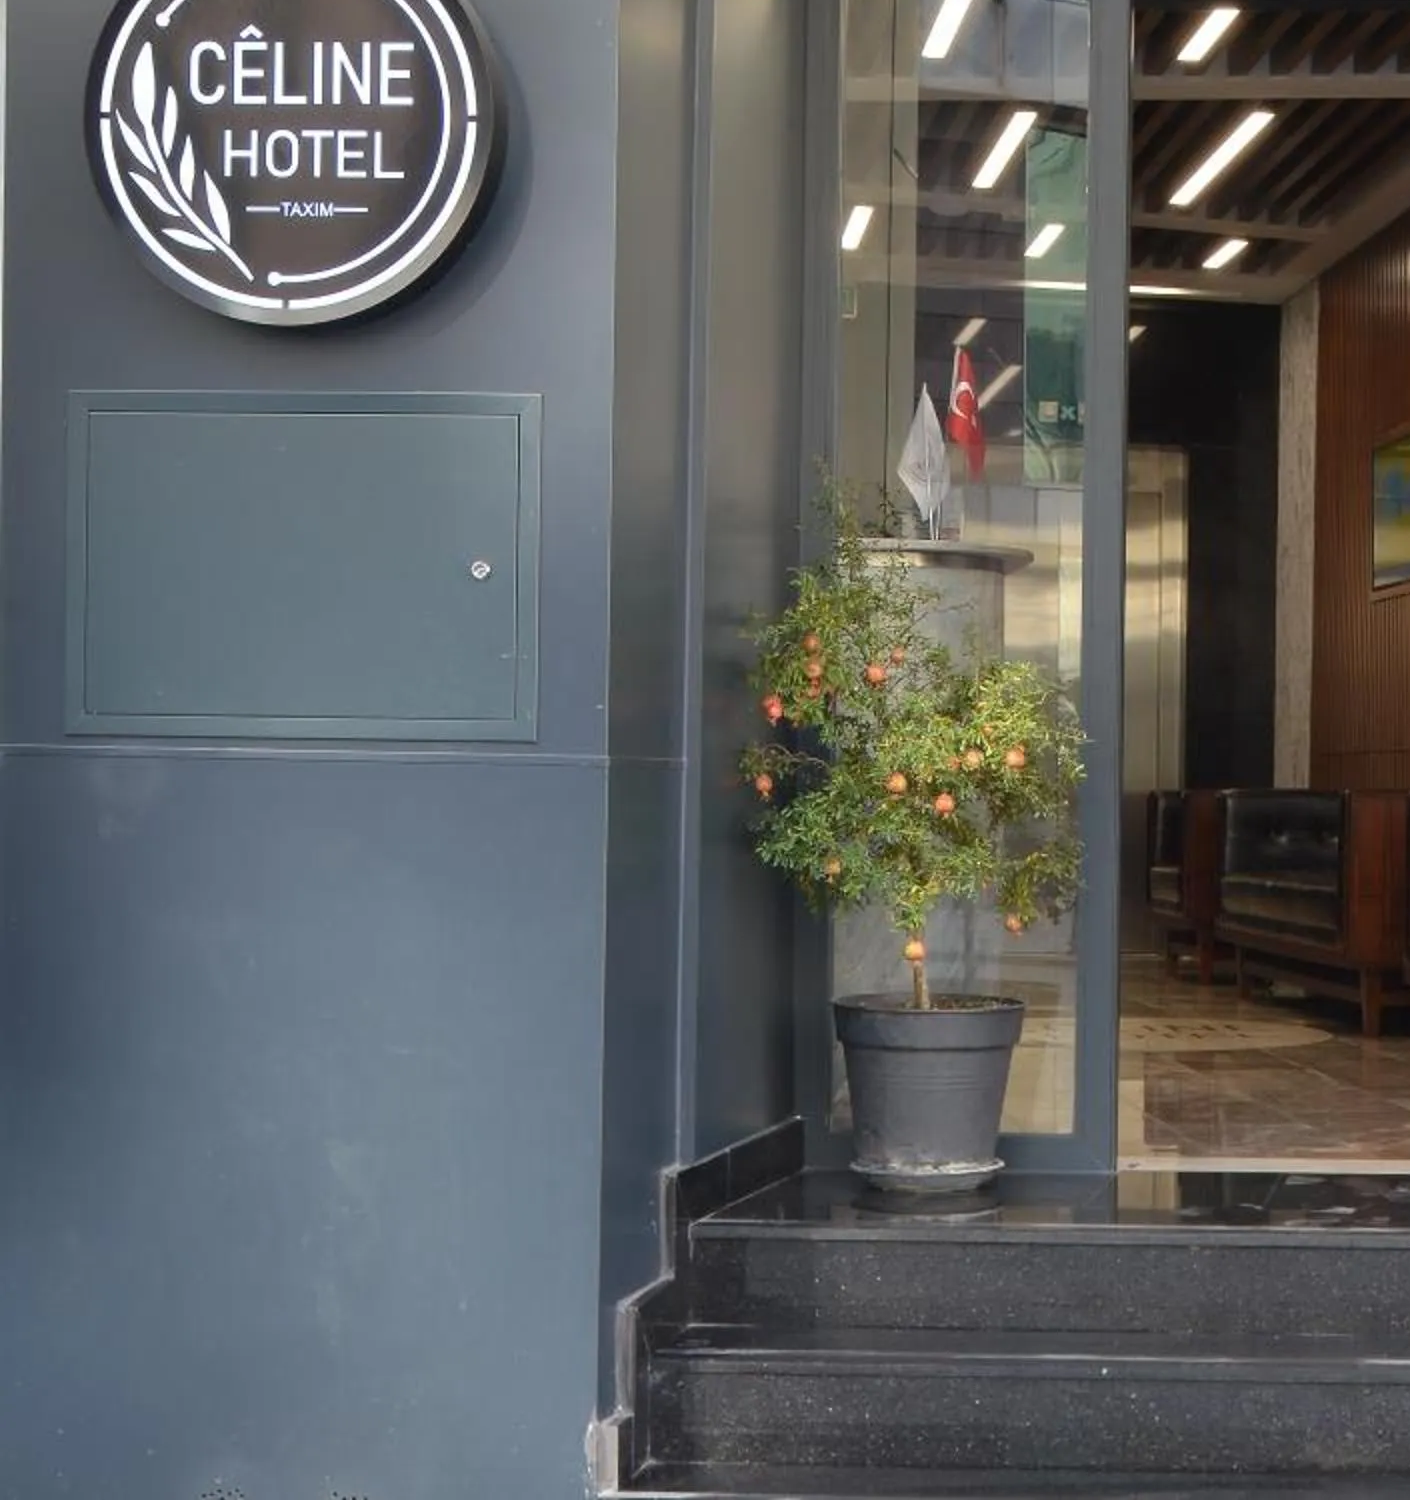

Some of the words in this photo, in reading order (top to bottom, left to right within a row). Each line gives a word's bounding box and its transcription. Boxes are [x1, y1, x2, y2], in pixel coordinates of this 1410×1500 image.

[189, 24, 415, 107] CÊLINE
[222, 129, 405, 180] HOTEL
[281, 201, 334, 217] TAXIM
